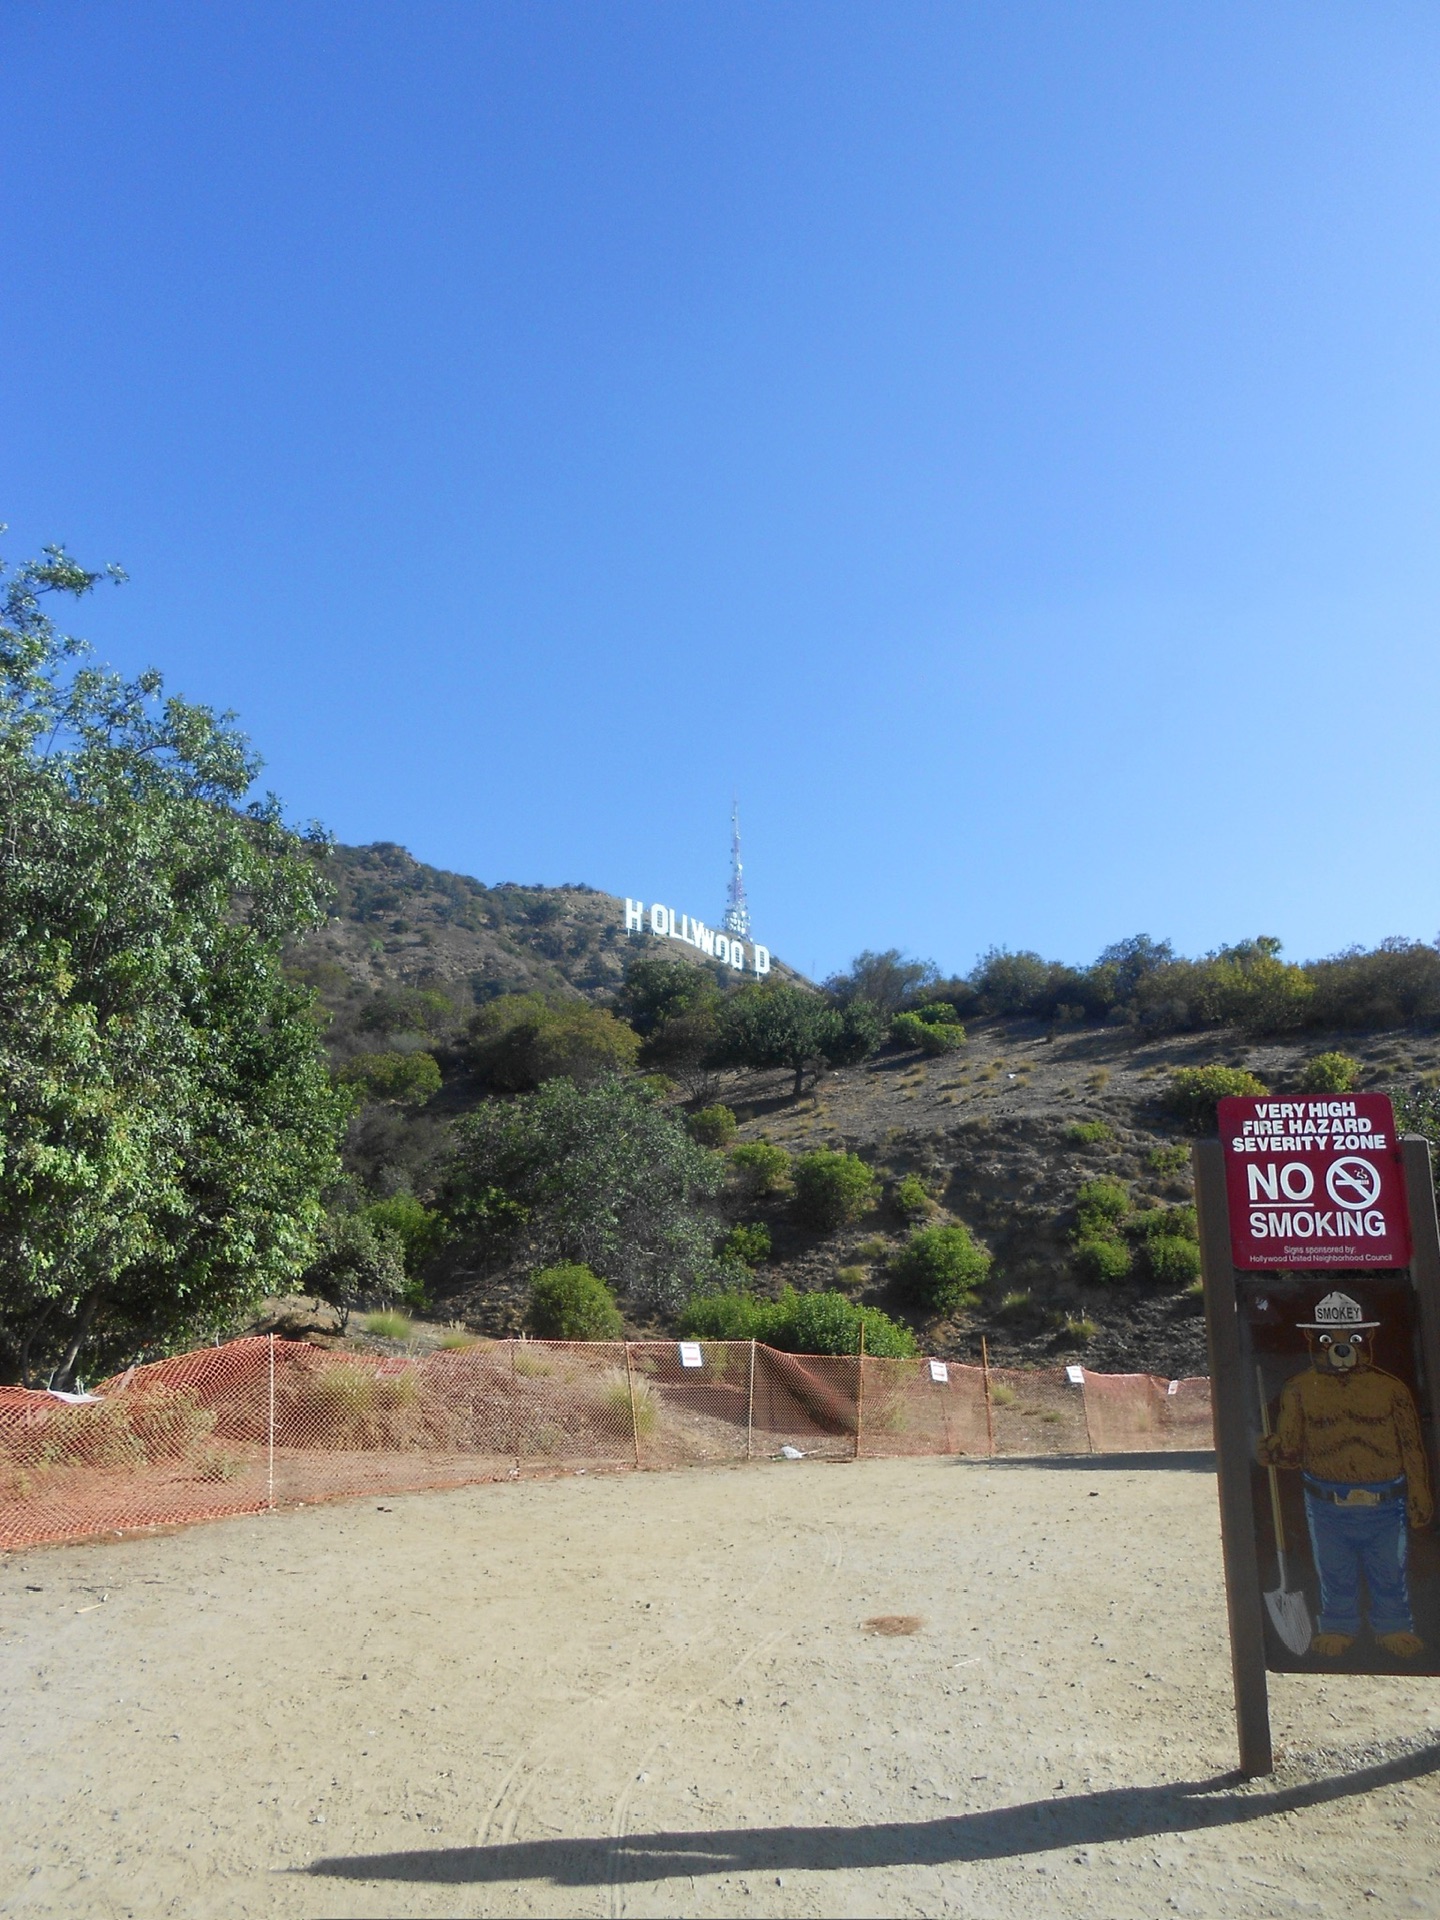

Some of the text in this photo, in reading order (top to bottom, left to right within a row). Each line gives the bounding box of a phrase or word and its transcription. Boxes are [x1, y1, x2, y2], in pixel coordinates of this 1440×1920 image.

[626, 898, 770, 974] HOLLYWOOD
[1255, 1101, 1356, 1119] VERY HIGH
[1243, 1118, 1371, 1135] FIRE HAZARD
[1232, 1134, 1387, 1152] SEVERITY ZONE
[1247, 1162, 1315, 1201] NO
[1249, 1210, 1387, 1238] SMOKING
[1250, 1255, 1287, 1263] Hollywood
[1313, 1254, 1364, 1263] Neighborhood
[1365, 1253, 1393, 1262] Council
[1284, 1245, 1304, 1256] Signs
[1305, 1246, 1344, 1255] sponsored
[1317, 1307, 1360, 1320] SMOKEY
